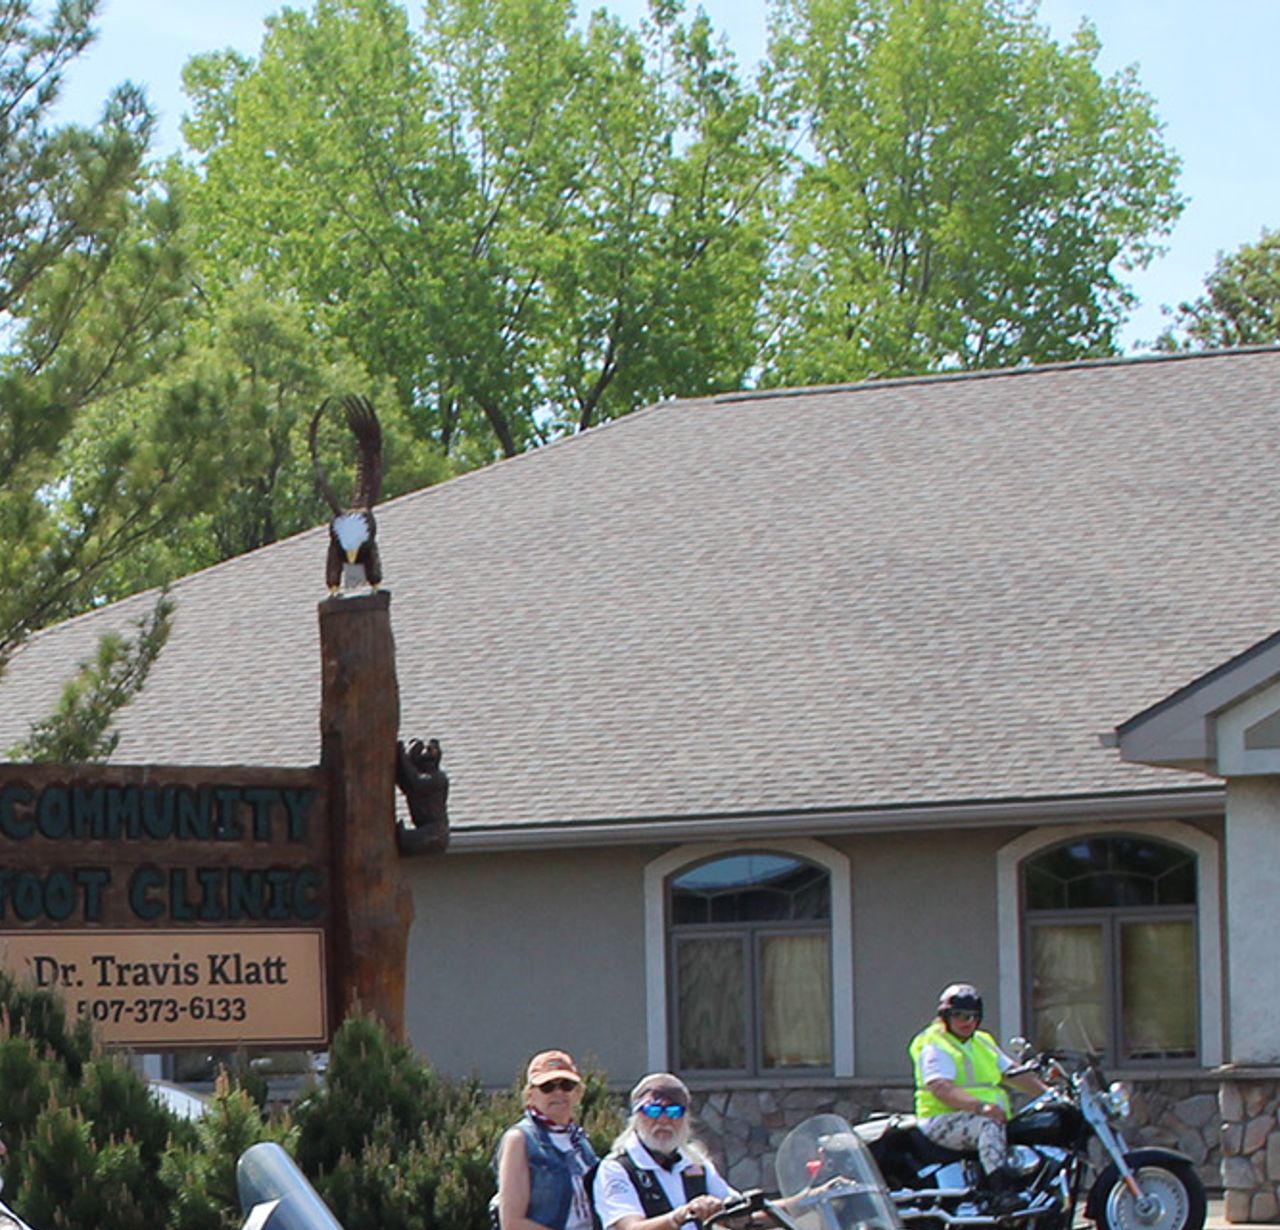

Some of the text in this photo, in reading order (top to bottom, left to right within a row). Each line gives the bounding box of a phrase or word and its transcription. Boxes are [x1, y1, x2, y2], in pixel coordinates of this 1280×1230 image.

[127, 862, 325, 922] CLINIC
[33, 953, 288, 987] Dr. Travis Klatt
